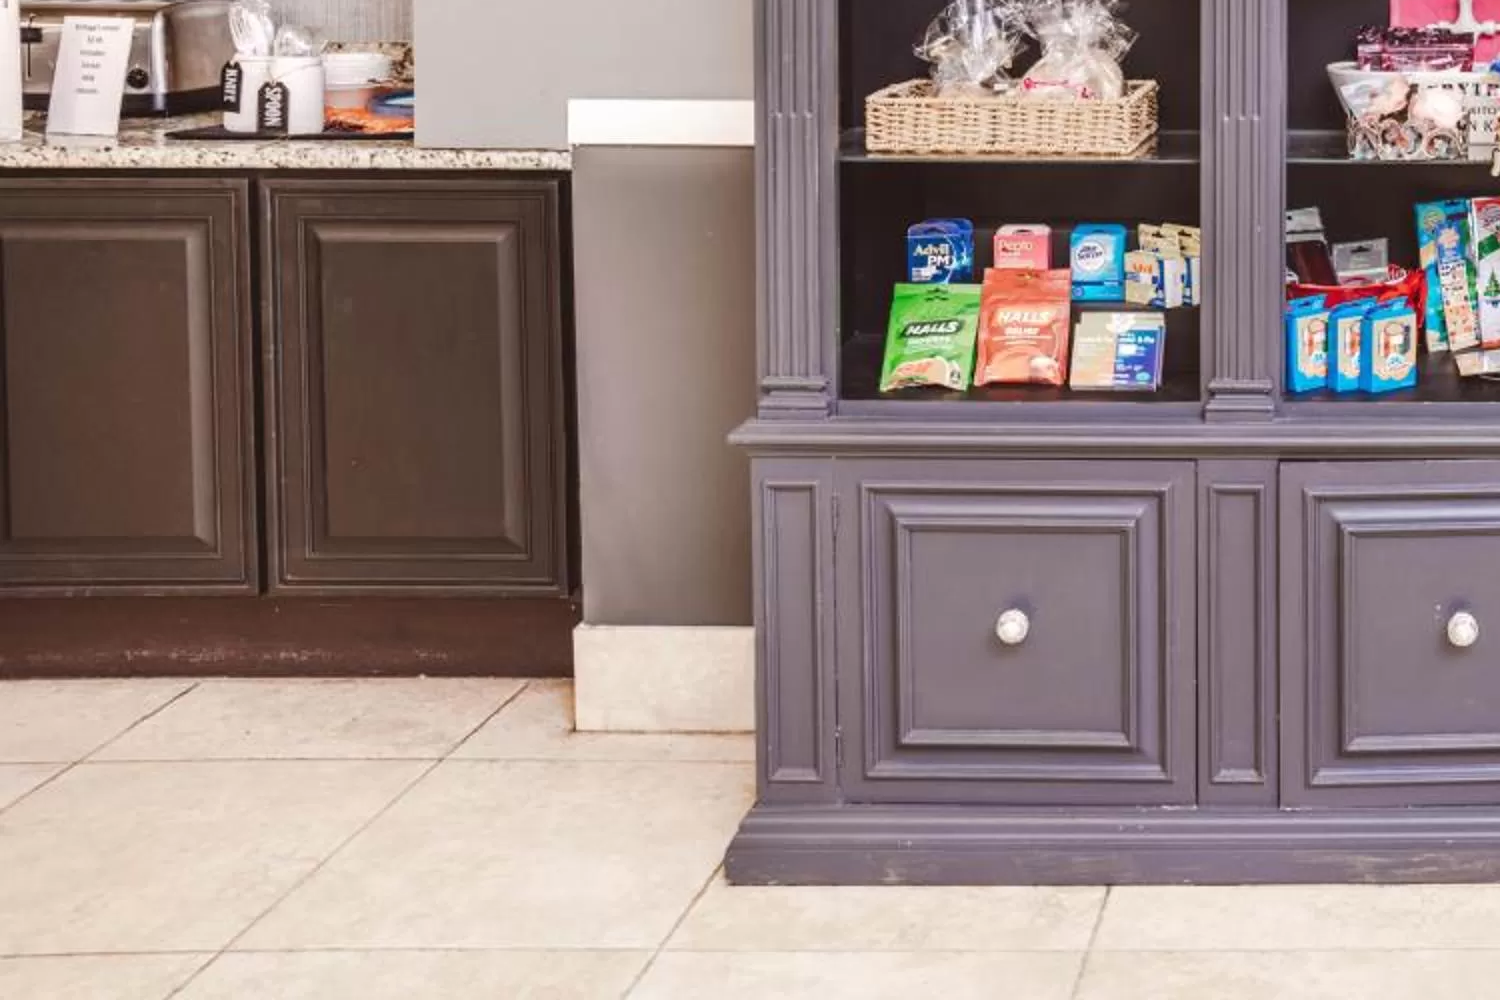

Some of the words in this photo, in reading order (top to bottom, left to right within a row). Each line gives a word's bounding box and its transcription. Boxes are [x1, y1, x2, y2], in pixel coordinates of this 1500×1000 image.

[223, 68, 239, 103] KNIFE
[264, 86, 283, 127] SPOON
[913, 243, 951, 257] Advil
[926, 256, 950, 268] PM
[998, 310, 1051, 324] HALLS
[904, 321, 961, 336] HALLS
